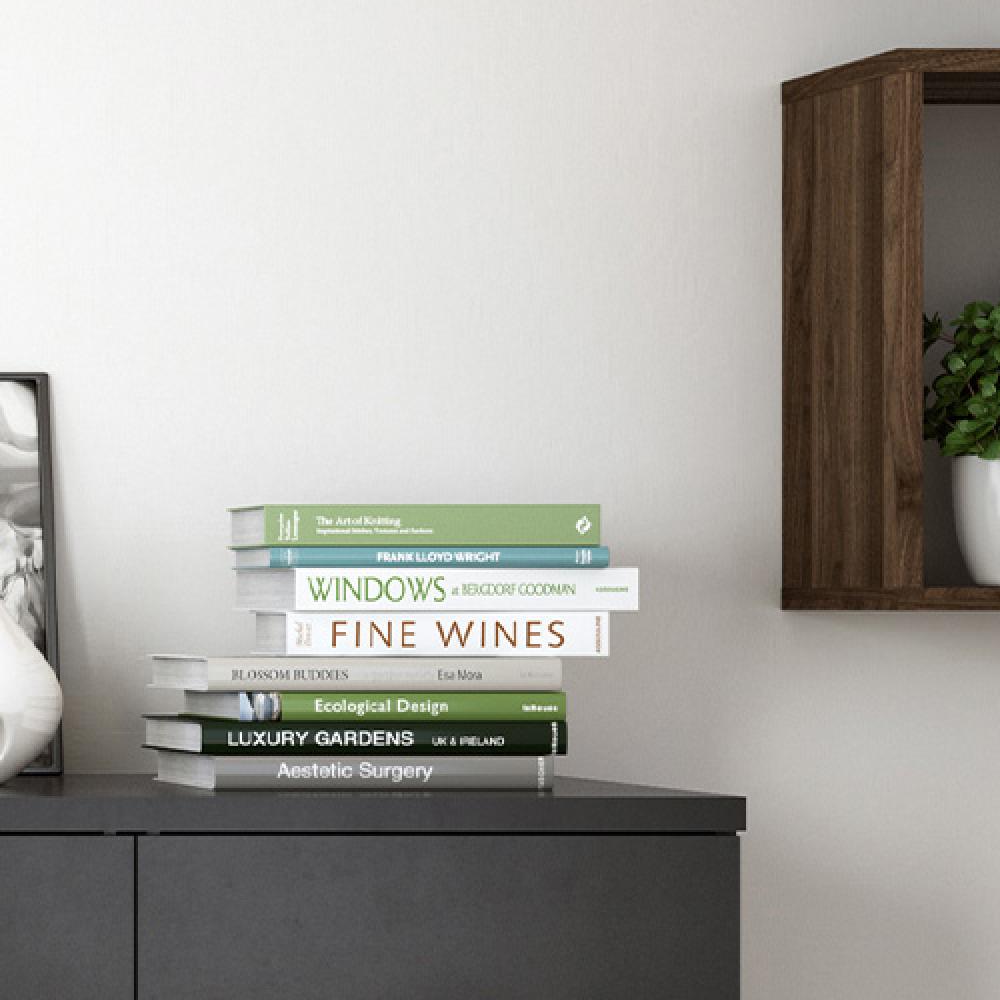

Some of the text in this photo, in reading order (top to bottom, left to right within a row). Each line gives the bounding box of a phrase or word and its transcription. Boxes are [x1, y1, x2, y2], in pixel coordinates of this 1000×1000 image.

[316, 516, 332, 526] The
[336, 516, 351, 526] Art
[362, 515, 401, 528] Knitting
[377, 552, 500, 562] FRANK LLOYD WRIGHT
[307, 576, 447, 602] WINDOWS
[462, 583, 515, 596] BERGDORF
[518, 583, 577, 596] GOODMAN
[332, 621, 417, 648] FINE
[435, 620, 565, 648] WINES
[231, 669, 290, 681] BLOSSOM
[293, 669, 349, 681] BUDDIES
[457, 669, 483, 680] Mora
[314, 698, 449, 716] Ecological Design
[227, 730, 415, 747] LUXURY GARDENS
[431, 735, 447, 747] UK
[459, 735, 505, 747] IRELAND
[277, 761, 433, 783] Aestetic Surgery
